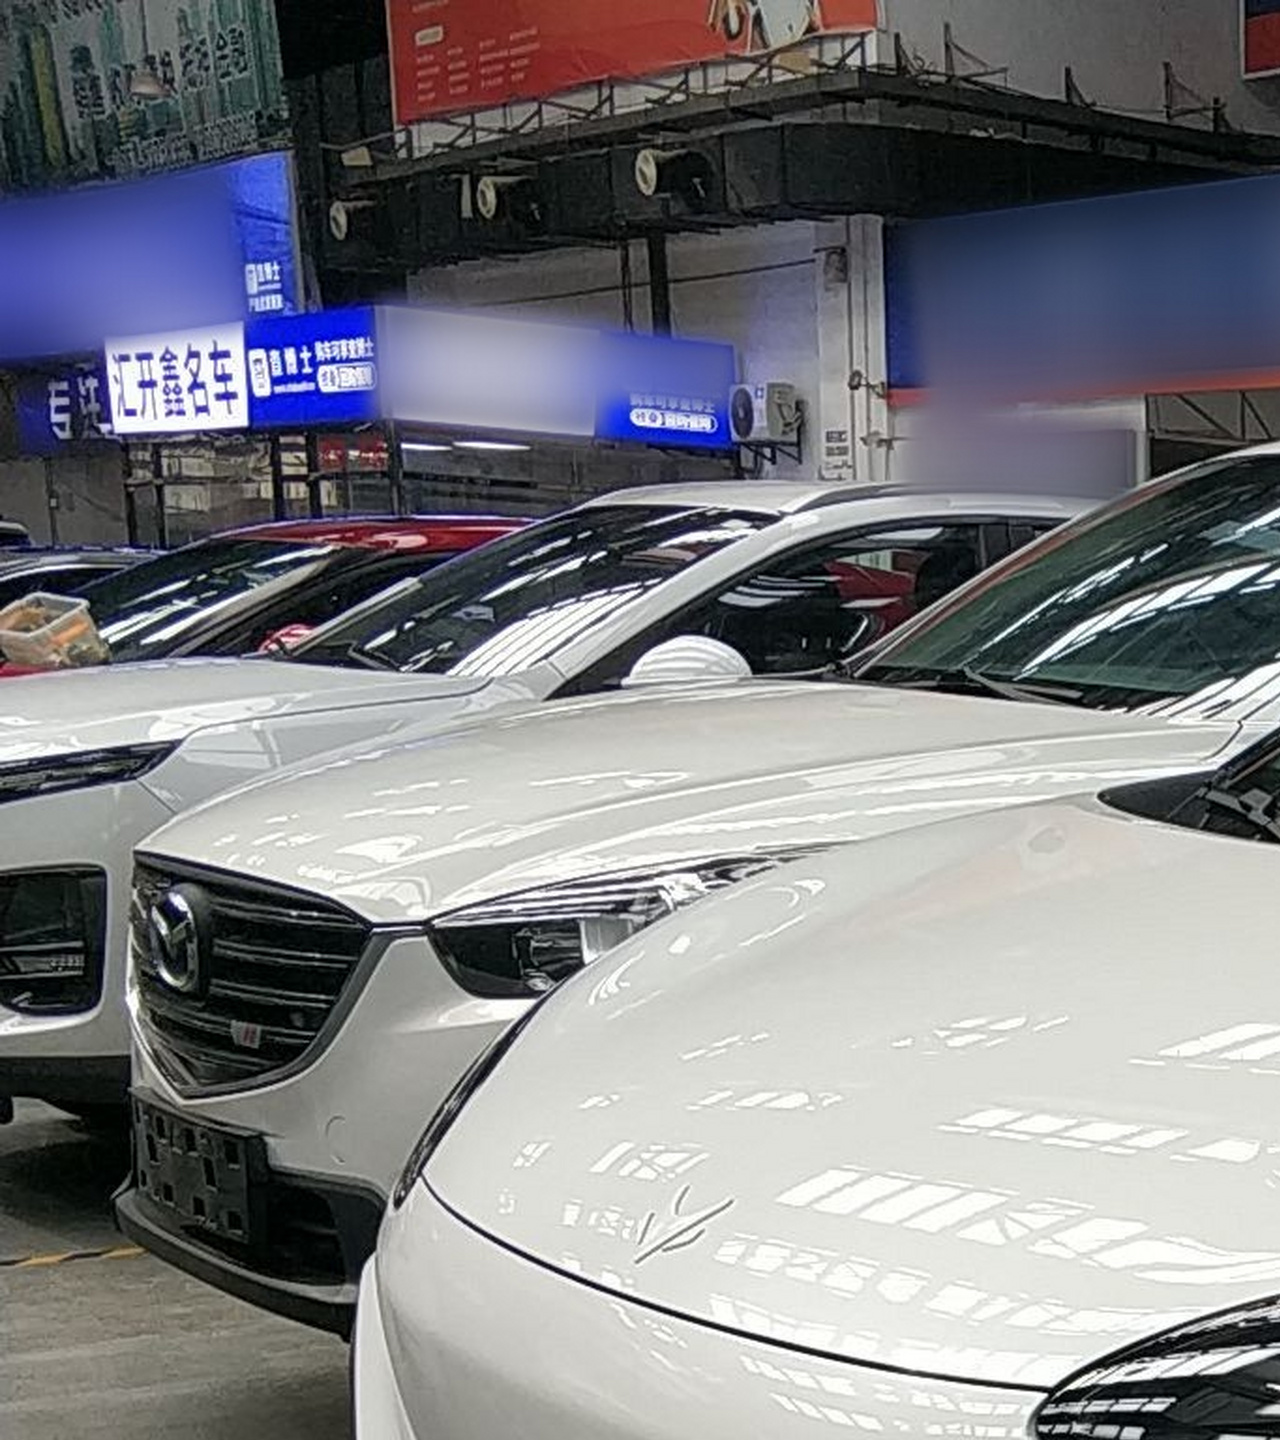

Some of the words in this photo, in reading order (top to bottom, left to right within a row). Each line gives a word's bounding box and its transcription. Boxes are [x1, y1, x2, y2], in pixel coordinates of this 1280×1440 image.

[112, 340, 239, 420] 汇开鑫名车
[269, 345, 314, 378] 查博士
